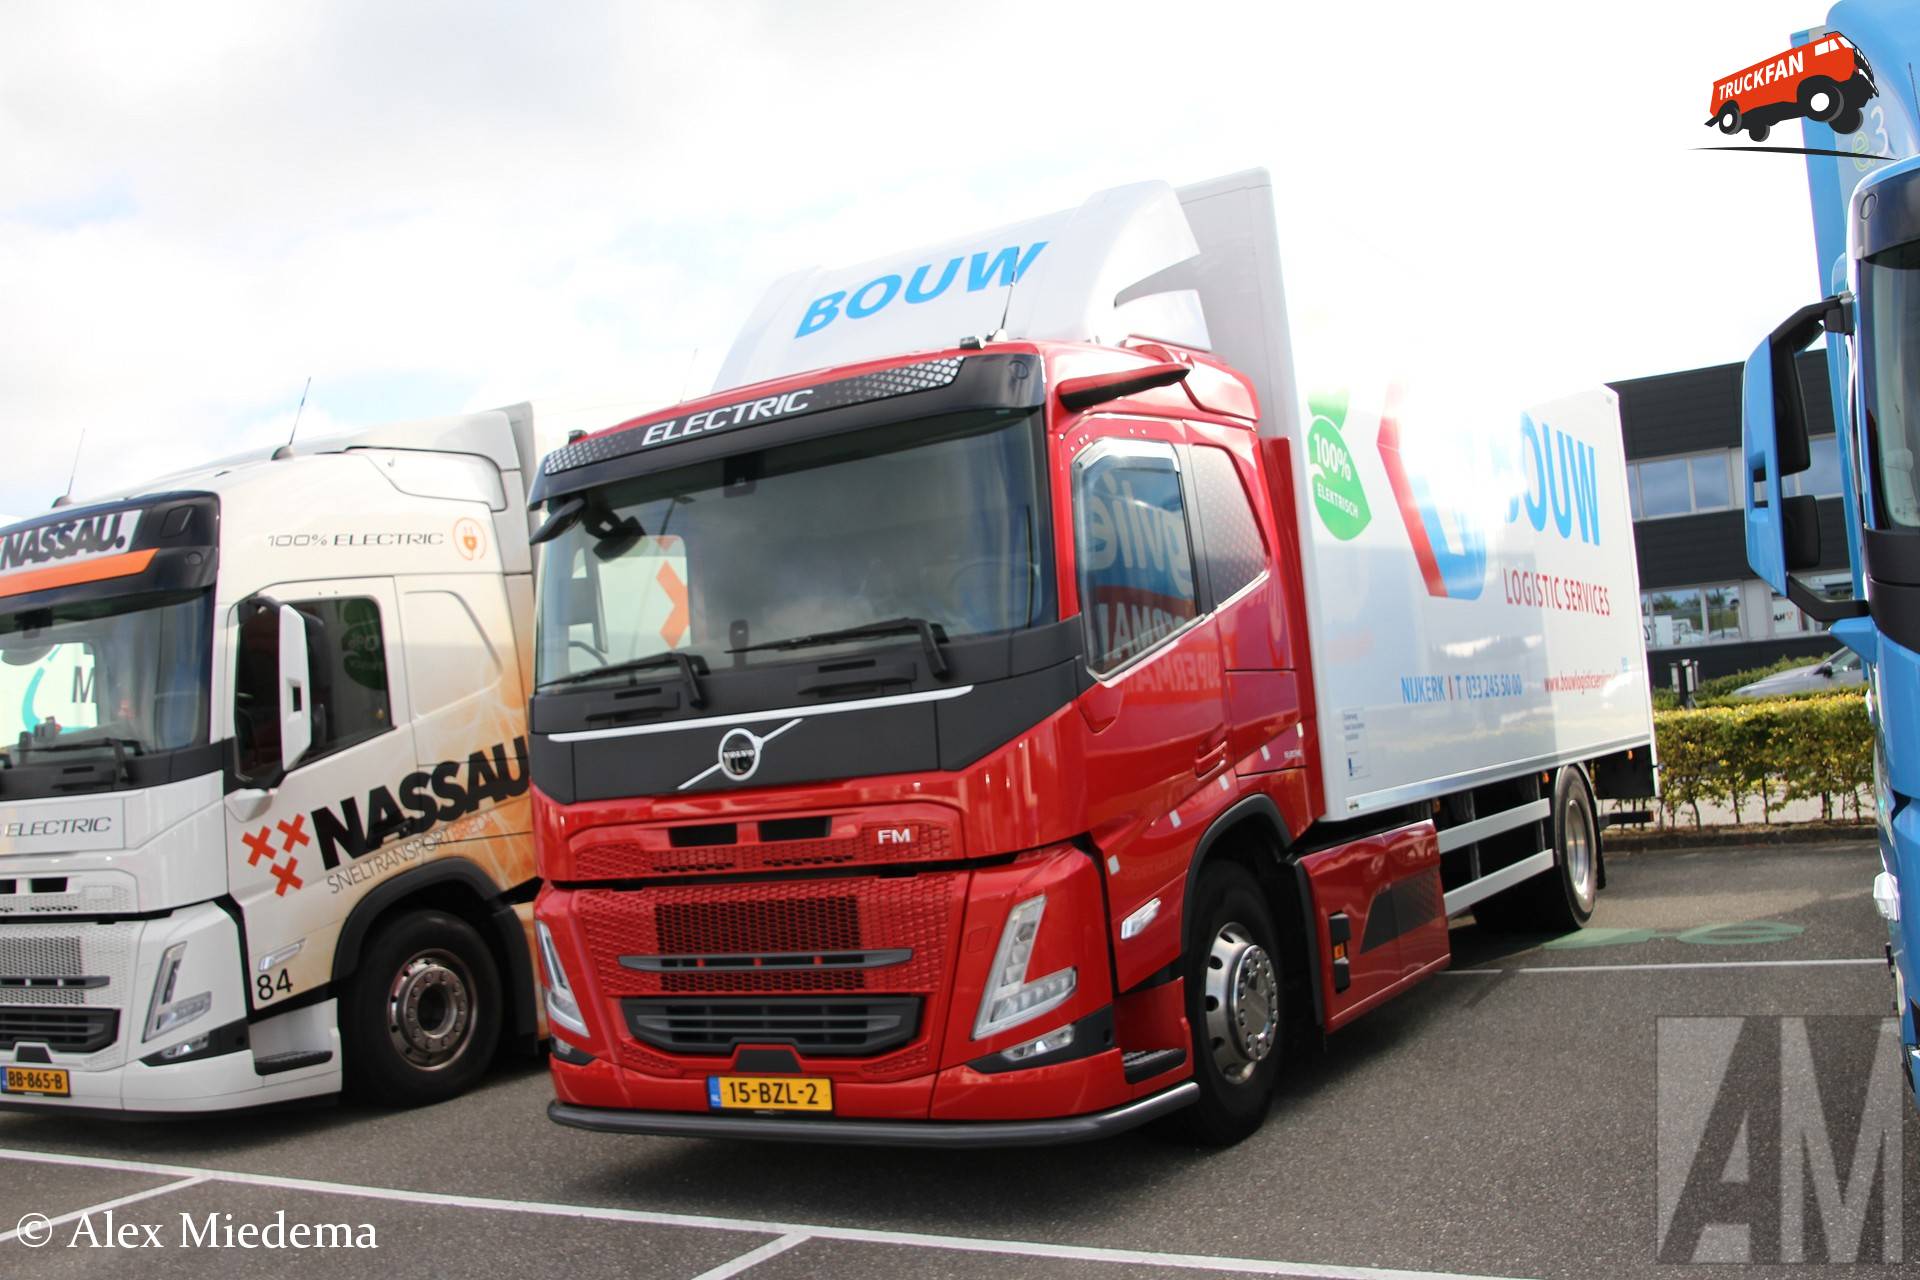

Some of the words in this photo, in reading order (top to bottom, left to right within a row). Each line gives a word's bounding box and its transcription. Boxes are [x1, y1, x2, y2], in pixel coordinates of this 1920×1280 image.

[794, 241, 1049, 339] BOUW
[641, 389, 814, 446] ELECTRIC
[1313, 433, 1352, 482] 100%
[1505, 411, 1600, 547] OUW
[1317, 483, 1359, 519] ELEKTRISCH
[268, 534, 327, 547] 100%
[334, 533, 444, 546] ELECTRIC
[1503, 568, 1562, 609] LOGISTIC
[1563, 578, 1610, 616] SERVICES
[1401, 676, 1445, 704] NIJKERK
[1466, 675, 1482, 699] 033
[1484, 674, 1500, 697] 245
[311, 736, 530, 871] NASSAU
[6, 816, 112, 837] ELECTRIC
[878, 828, 911, 845] FM
[327, 829, 449, 894] SNELTRANSPORT
[257, 968, 293, 1001] 84
[8, 1070, 63, 1090] BB-865-B
[729, 1081, 819, 1105] 15-BZL-2
